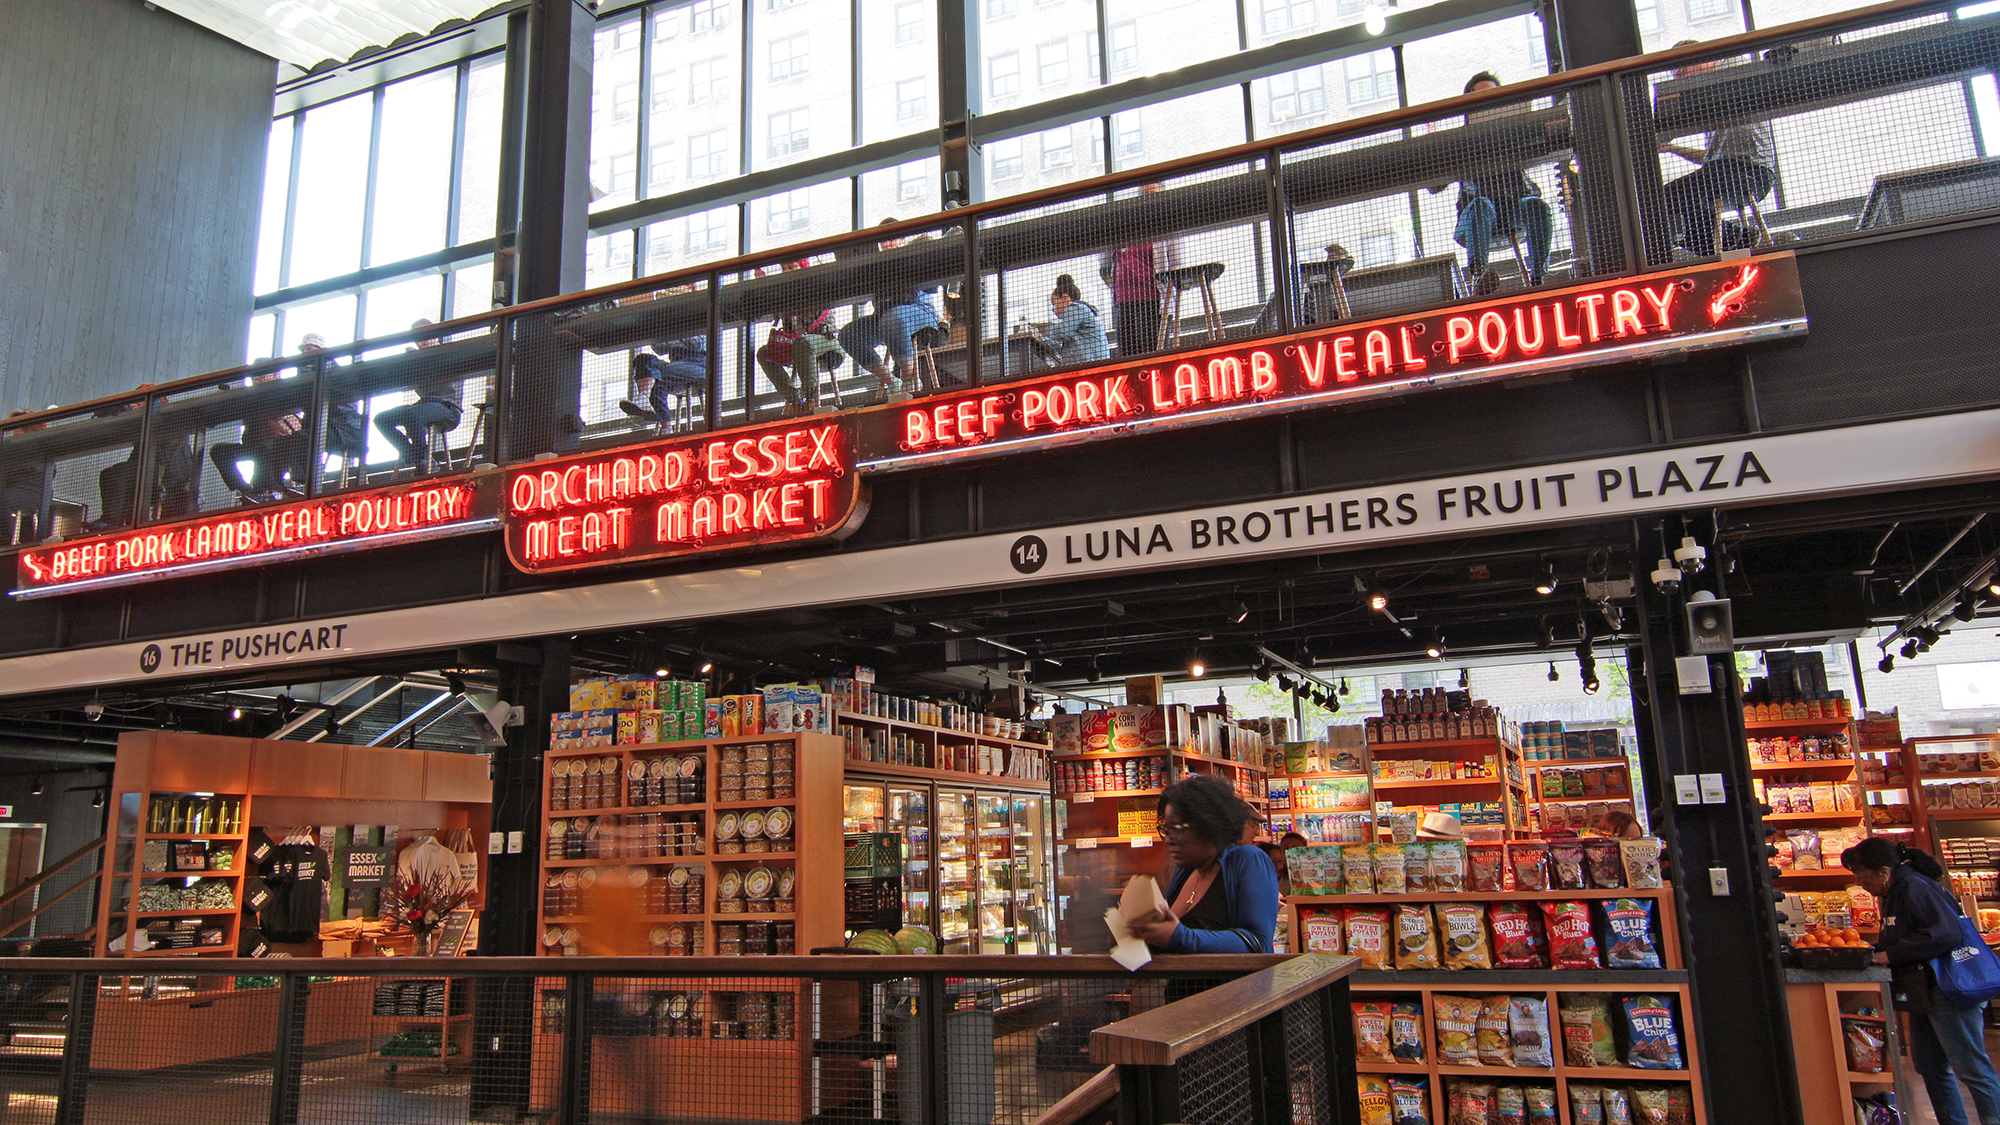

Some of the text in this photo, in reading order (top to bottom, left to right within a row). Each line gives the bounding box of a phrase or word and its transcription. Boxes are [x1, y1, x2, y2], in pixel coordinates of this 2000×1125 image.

[906, 282, 1677, 448] BEEF PORK LAMB VEAL POULTRY
[512, 426, 837, 512] ORCHARD ESSEX
[1016, 450, 1772, 565] 14 LUNA BROTHERS FRUIT PLAZA
[525, 479, 830, 560] MEAT MARKET
[52, 486, 462, 579] BEEF PORK LAMB VEAL POULTRY
[142, 624, 348, 668] 16 THE PUSHCART
[350, 853, 377, 864] ESSEX
[349, 865, 385, 876] MARKET
[1401, 923, 1425, 931] BOWLS
[1450, 922, 1475, 930] BOWLS
[1493, 919, 1530, 934] RED HO
[1552, 919, 1591, 936] RED HOT
[1610, 919, 1648, 933] BLUE
[1505, 930, 1525, 938] Blues
[1563, 930, 1582, 939] Blues
[1570, 996, 1599, 1006] Salsa
[1632, 1018, 1672, 1032] BLUE
[1644, 1028, 1669, 1037] Chips
[1360, 1097, 1391, 1108] YELLOW
